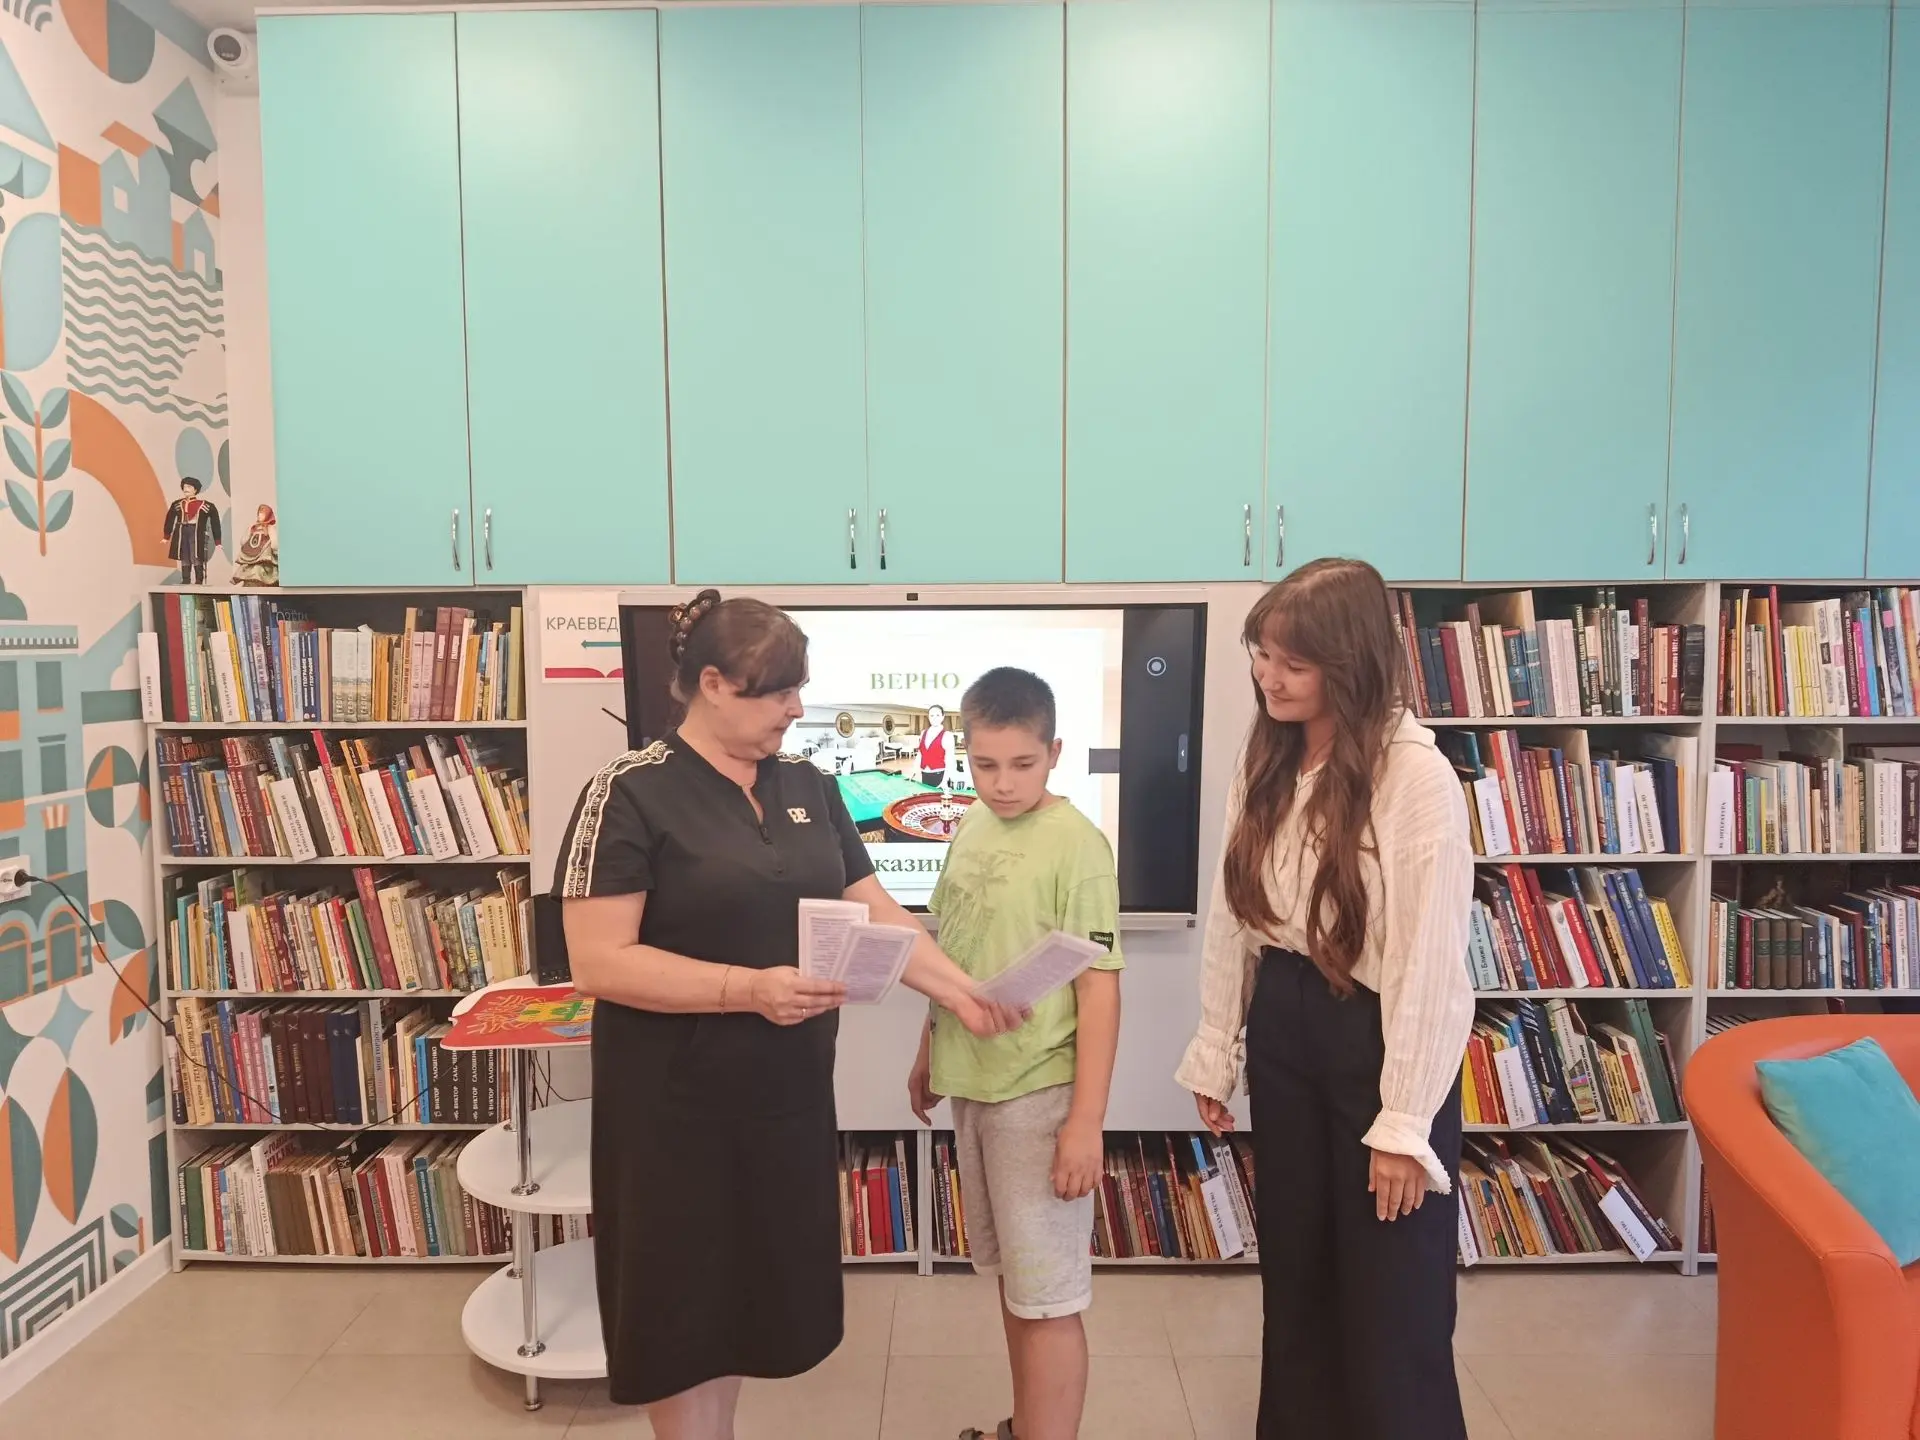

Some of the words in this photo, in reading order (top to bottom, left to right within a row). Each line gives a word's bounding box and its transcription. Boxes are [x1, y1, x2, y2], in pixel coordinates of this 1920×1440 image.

[546, 616, 619, 632] КРАЕВЕД
[870, 672, 960, 690] ВЕРНО
[874, 858, 945, 873] казин
